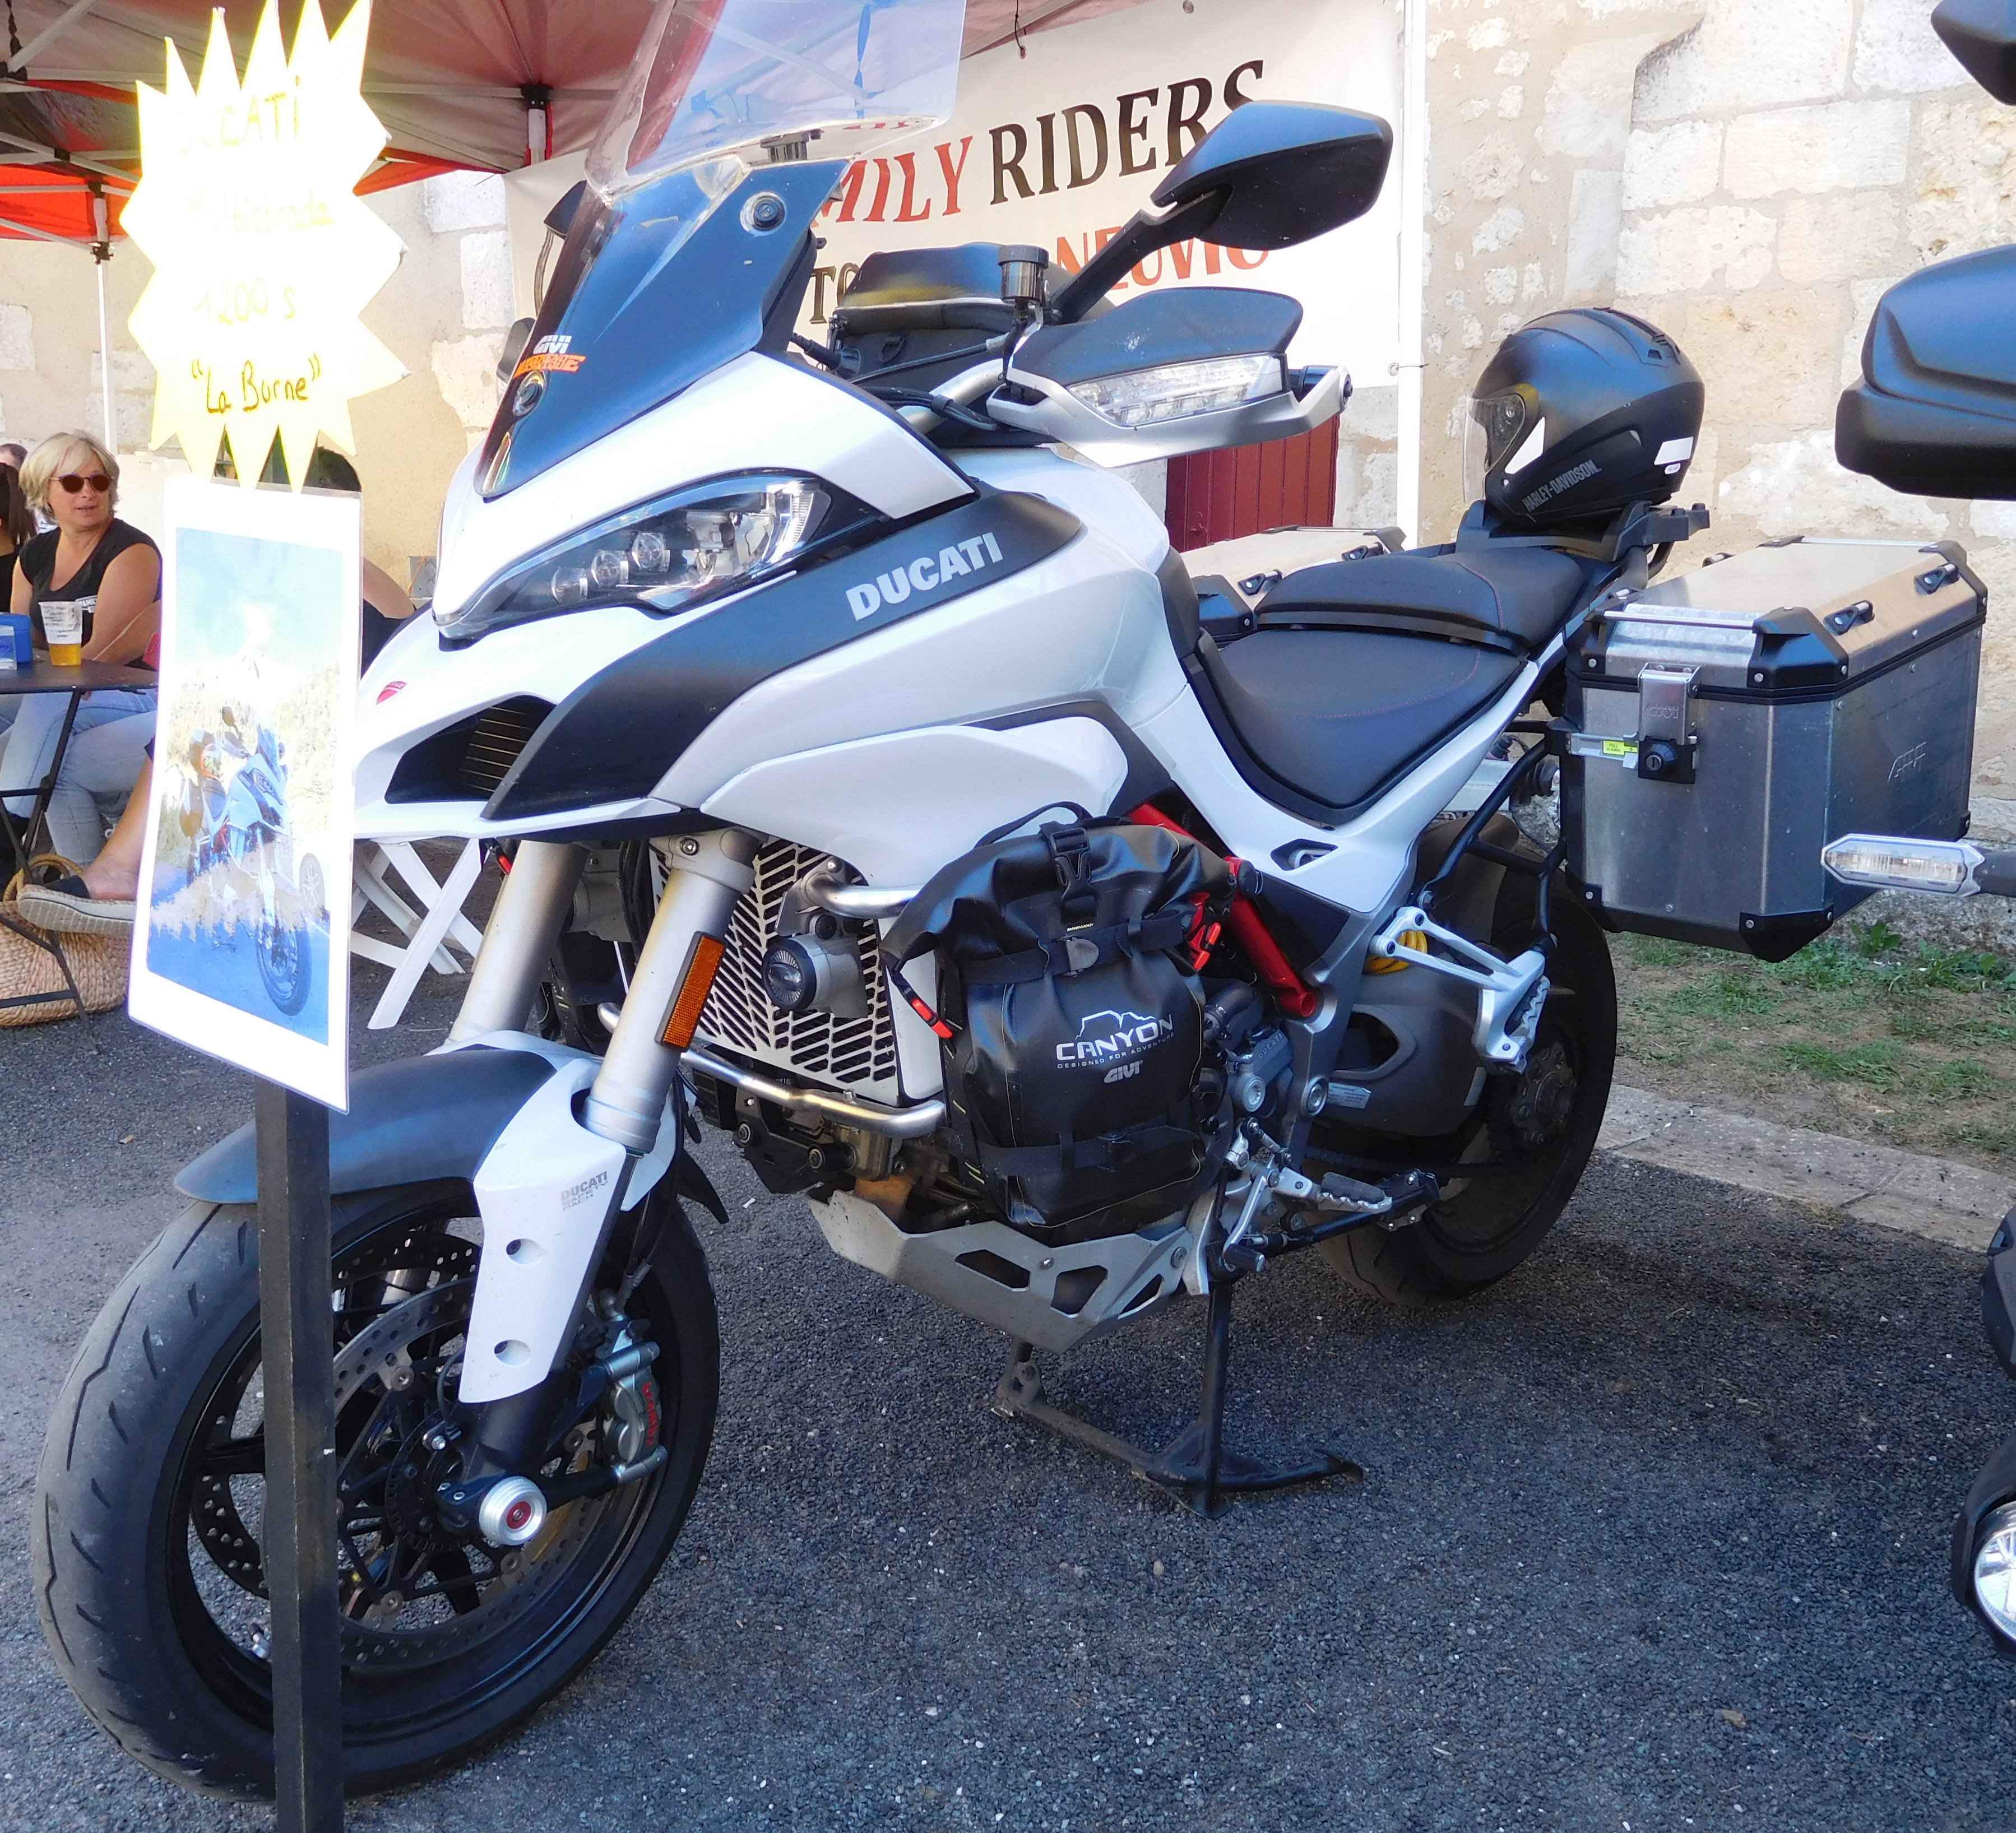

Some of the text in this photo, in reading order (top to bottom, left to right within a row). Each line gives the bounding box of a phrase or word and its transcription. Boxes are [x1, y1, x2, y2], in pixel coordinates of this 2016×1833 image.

[810, 136, 974, 226] MILY
[192, 277, 269, 324] 1200
[1522, 460, 1600, 512] HARLEY-DAVIDSON
[845, 532, 1004, 622] DUCATI
[1056, 1014, 1173, 1061] CANYON
[1057, 1032, 1175, 1069] DESIGNED FOR ADVENTURE
[1259, 1032, 1283, 1060] DUCATI
[560, 1171, 608, 1201] DUCATI
